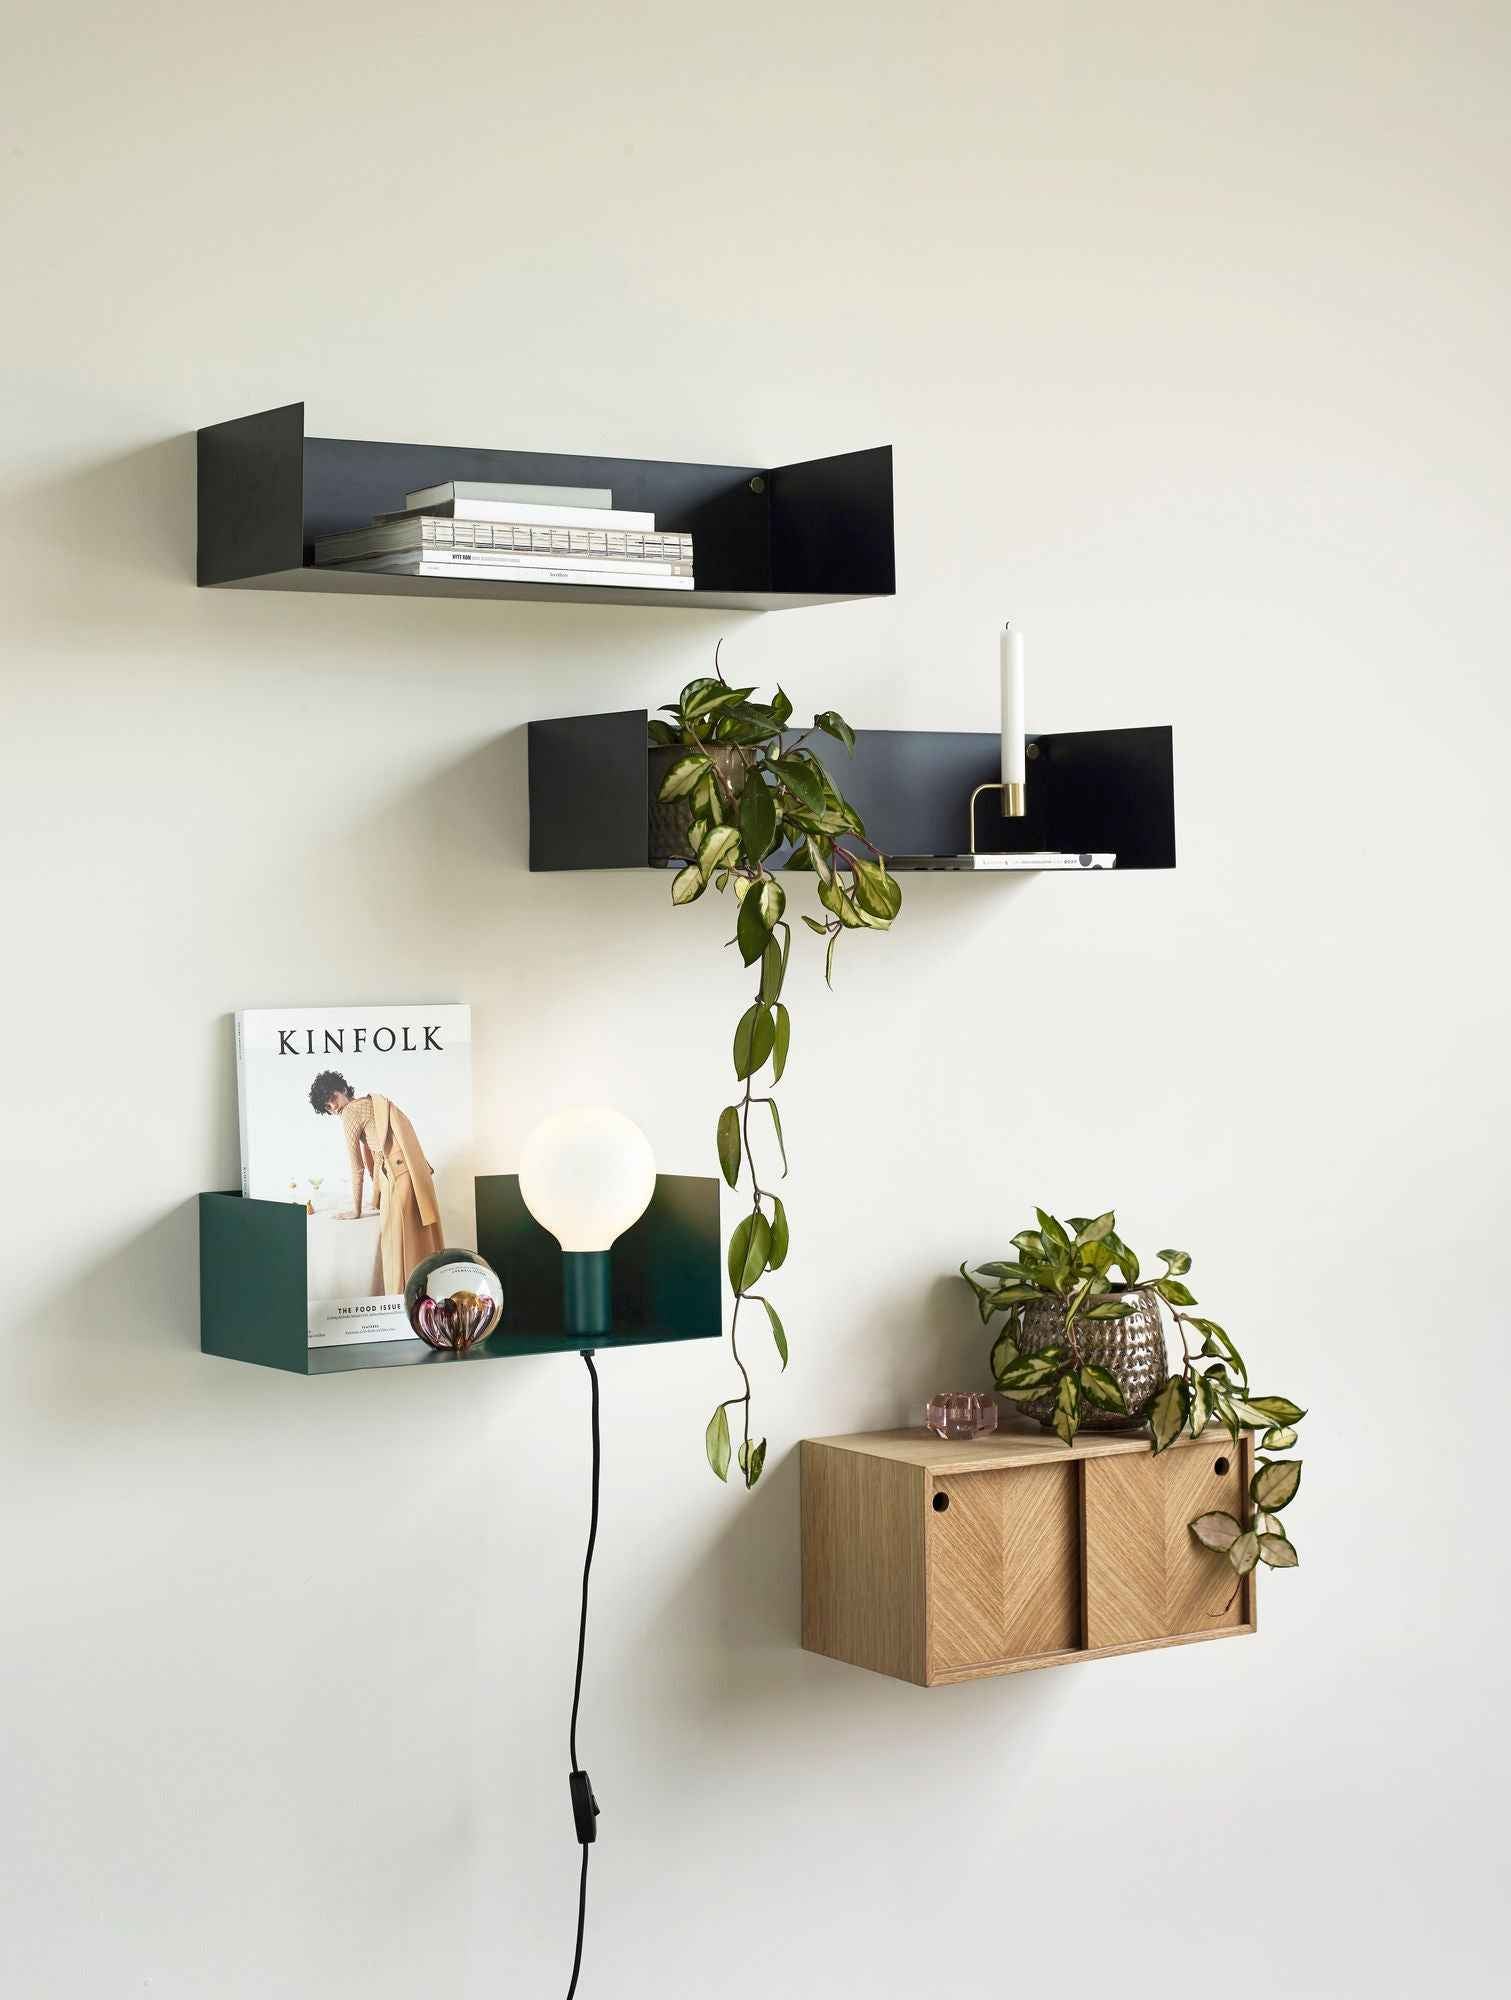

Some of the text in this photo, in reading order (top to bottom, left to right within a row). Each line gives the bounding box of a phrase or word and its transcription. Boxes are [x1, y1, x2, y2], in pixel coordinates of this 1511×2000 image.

[278, 1026, 444, 1055] KINFOLK
[355, 1305, 377, 1313] FOOD
[380, 1303, 401, 1311] ISSUE
